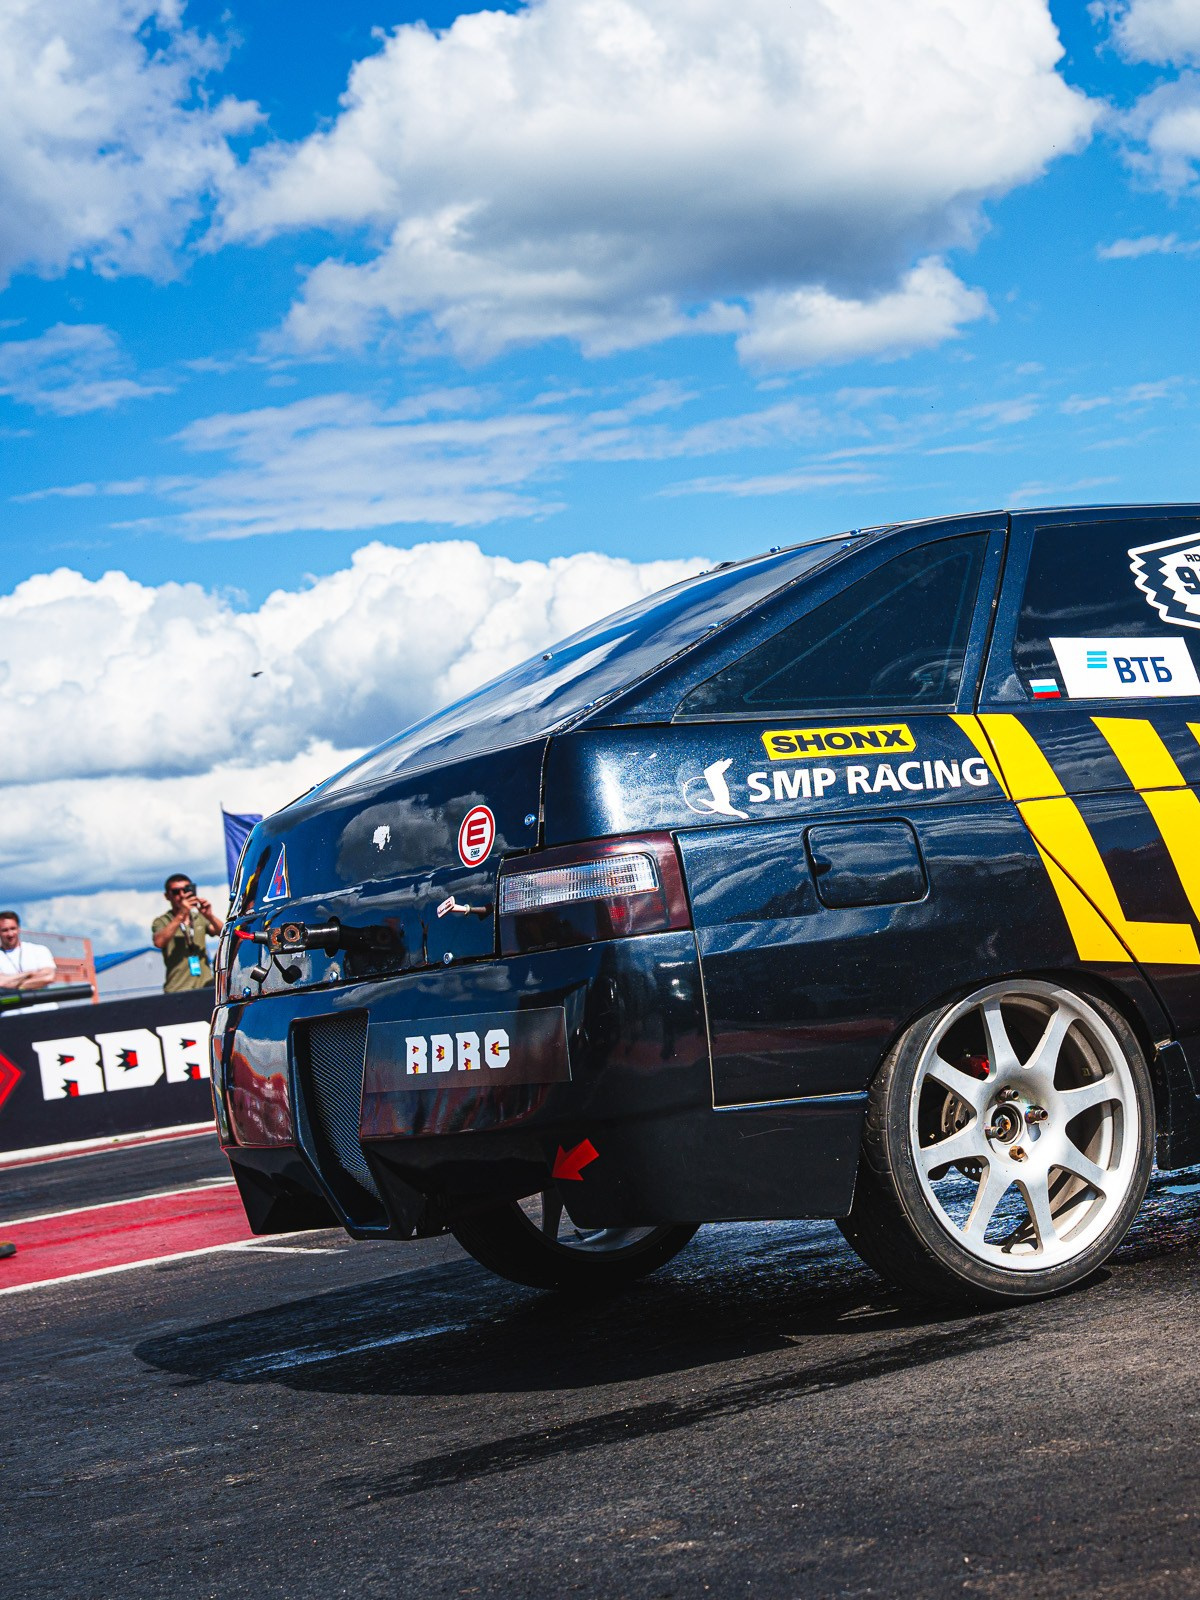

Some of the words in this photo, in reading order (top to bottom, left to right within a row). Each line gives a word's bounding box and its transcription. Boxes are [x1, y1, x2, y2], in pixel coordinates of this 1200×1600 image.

[1113, 656, 1173, 684] ВТБ
[769, 729, 910, 754] SHONX
[749, 767, 837, 803] SMP
[847, 757, 989, 795] RACING
[467, 816, 487, 848] E
[405, 1028, 510, 1075] RDRC
